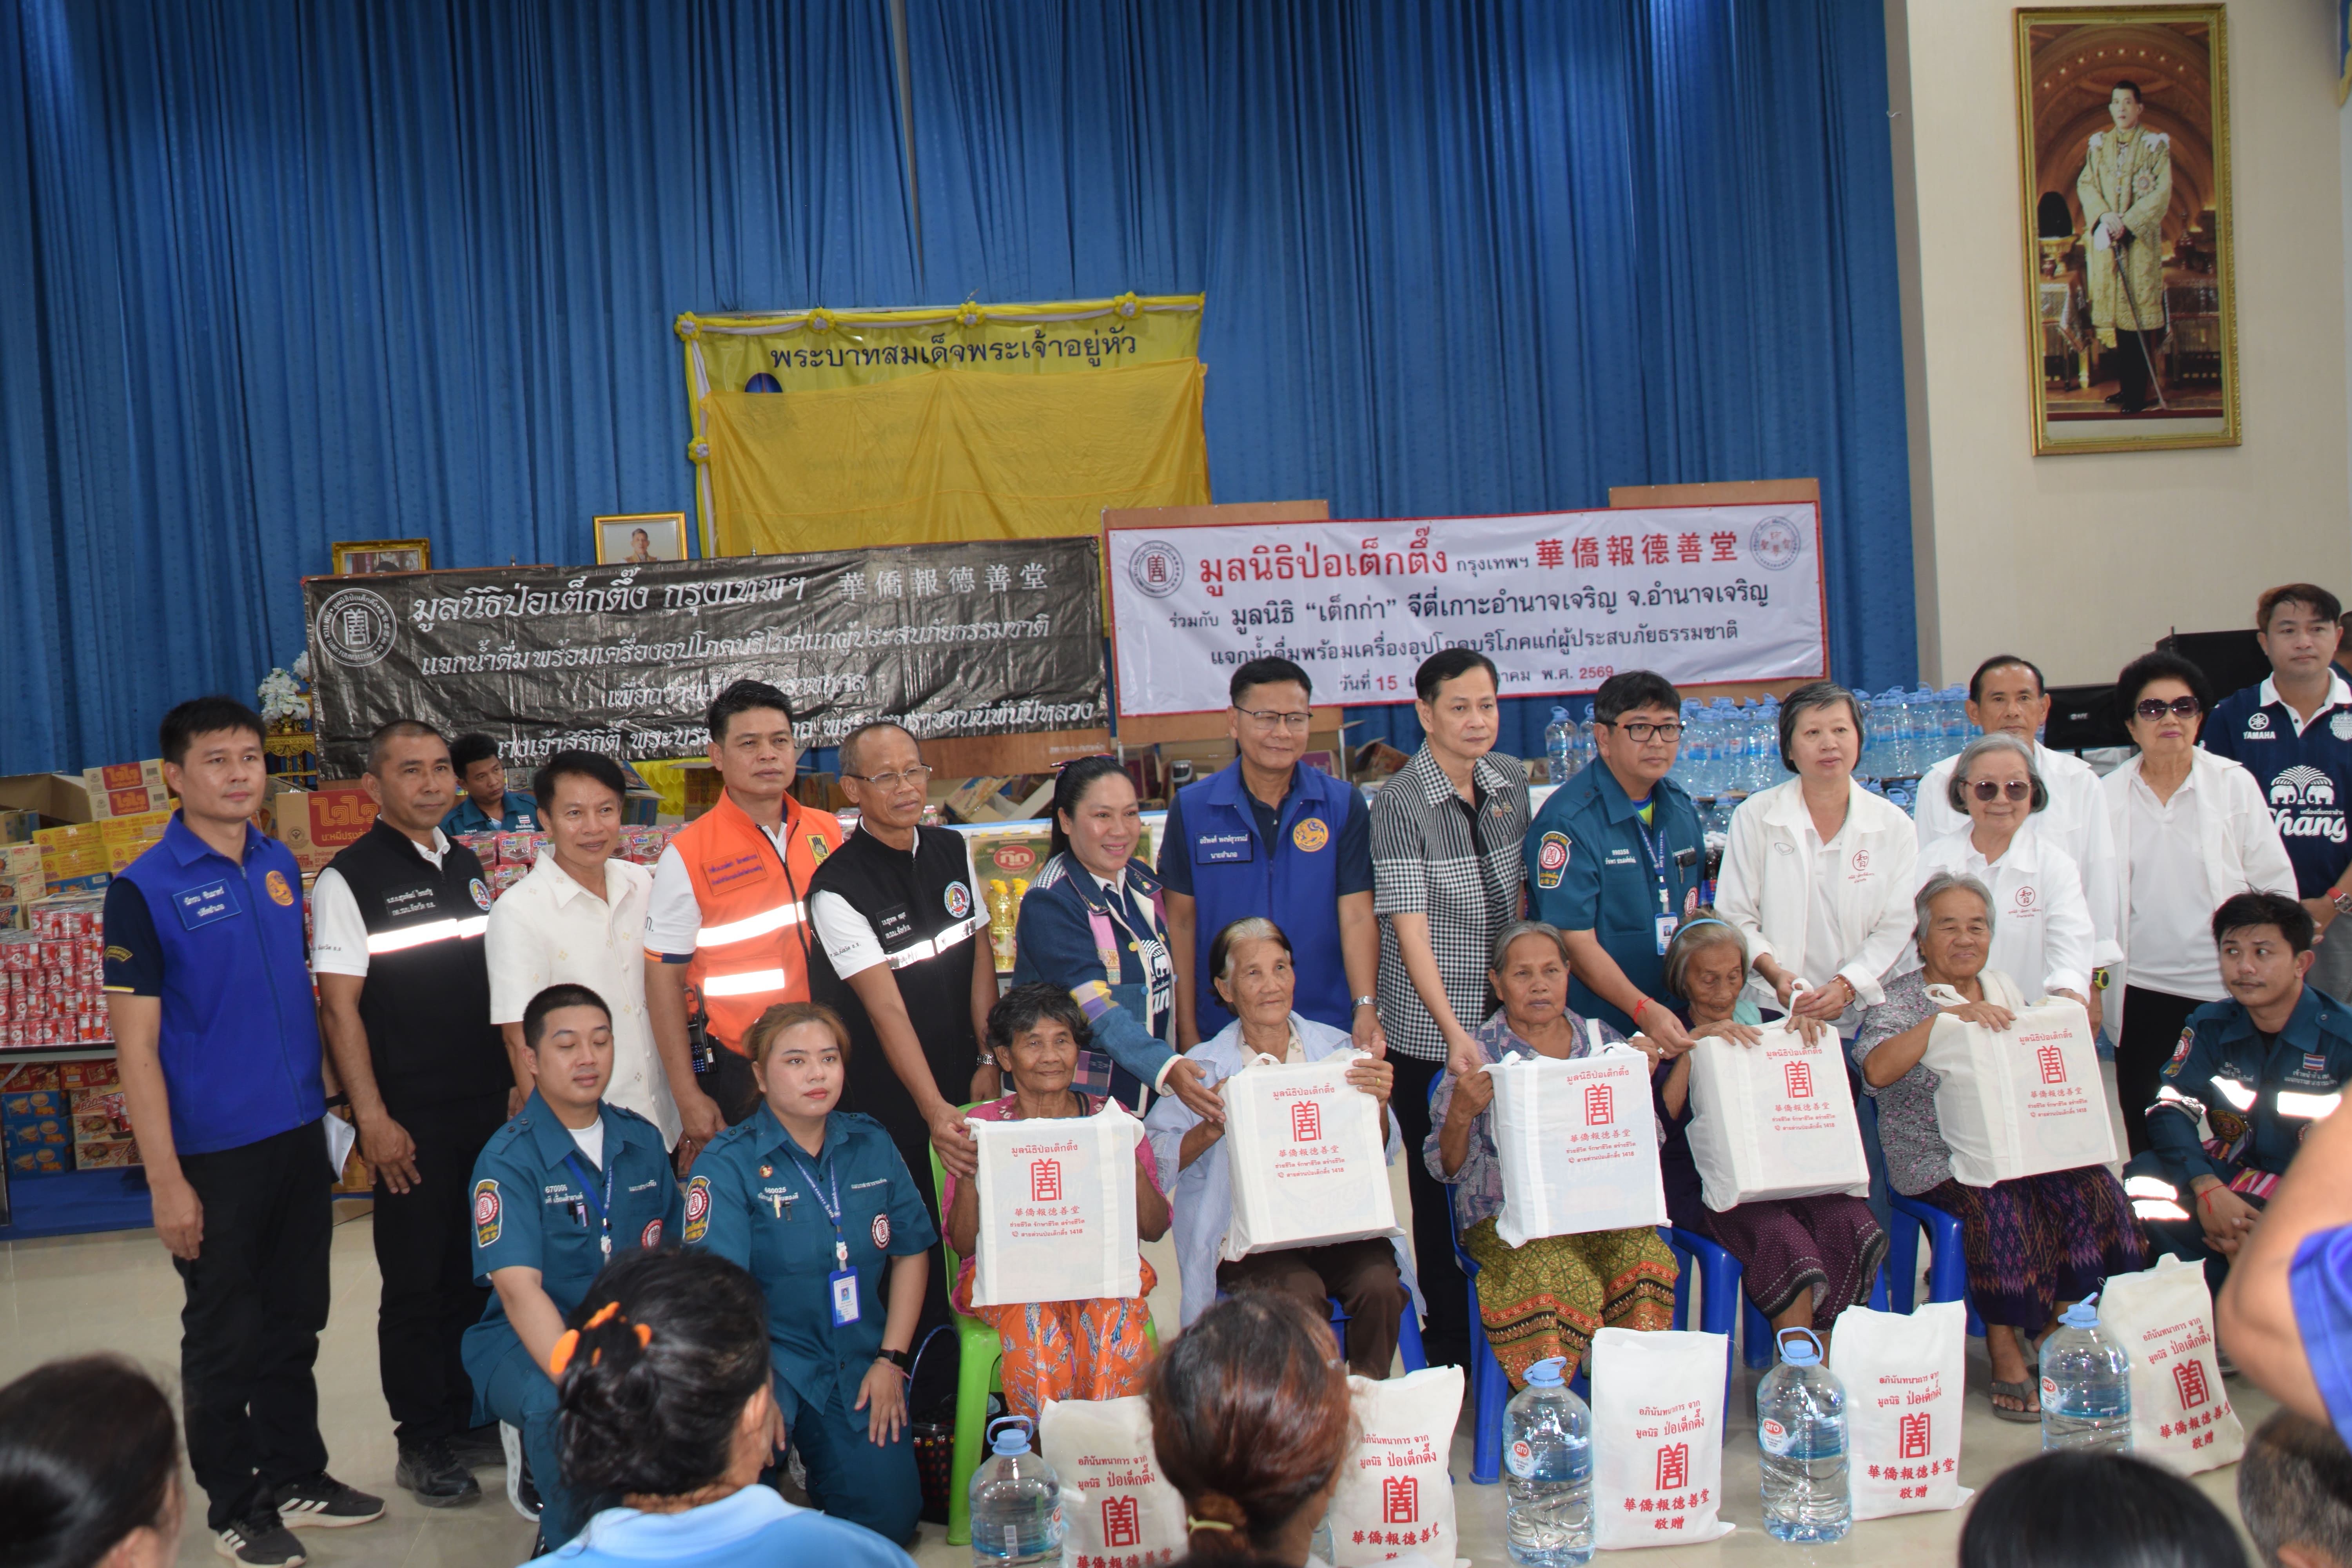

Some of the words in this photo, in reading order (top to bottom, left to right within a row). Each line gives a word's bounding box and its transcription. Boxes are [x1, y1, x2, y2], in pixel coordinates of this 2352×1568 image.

[771, 327, 1136, 369] พระบาทสมเด็จพระเจ้าอยู่หัว
[1535, 530, 1738, 570] 華僑報德善堂
[1200, 526, 1448, 597] มูลนิธิป่อเต็กตึ๊ง
[1456, 555, 1529, 577] กรุงเทพฯ
[838, 563, 1048, 600] 華僑報德善堂
[413, 567, 649, 632] มูลนิธิป่อเต็กตึ๊ง
[663, 576, 806, 616] กรุงเทพฯ
[1169, 612, 1219, 628] ร่วมกับ
[1232, 599, 1294, 634] มูลนิธิ
[1408, 586, 1617, 617] จีตี่เกาะอำนาจเจริญ
[1628, 578, 1768, 607] จ.อำนาจเจริญ
[1339, 670, 1370, 691] วันที่
[1376, 676, 1397, 690] 15
[1542, 668, 1572, 681] พ.ศ.
[1579, 666, 1613, 679] 2569
[2020, 890, 2032, 904] 智
[1567, 1065, 1629, 1085] มูลนิธิป่อเต็กตึ๊ง
[1273, 1083, 1335, 1100] มูลนิธิป่อเต็กตึ๊ง
[1011, 1140, 1078, 1157] มูลนิธิป่อเต็กตึ๊ง
[1015, 1205, 1080, 1217] 華僑報德善堂
[2188, 1317, 2201, 1327] จาก
[2148, 1349, 2167, 1364] มูลนิธิ
[2171, 1326, 2211, 1355] ป่อเต็กตึ๊ง
[1878, 1396, 1900, 1408] มูลนิธิ
[1906, 1379, 1942, 1405] ป่อเต็กตึ๊ง
[2043, 1379, 2053, 1390] aro
[1688, 1400, 1700, 1409] จาก
[1636, 1428, 1658, 1439] มูลนิธิ
[1664, 1408, 1704, 1436] ป่อเต็กตึ๊ง
[1765, 1422, 1780, 1432] aro
[1414, 1434, 1429, 1443] จาก
[1516, 1444, 1528, 1455] aro
[1134, 1455, 1147, 1464] จาก
[1360, 1456, 1381, 1469] มูลนิธิ
[1387, 1443, 1437, 1467] ป่อเต็กตึ๊ง
[1078, 1477, 1100, 1490] มูลนิธิ
[1107, 1463, 1155, 1487] ป่อเต็กตึ๊ง
